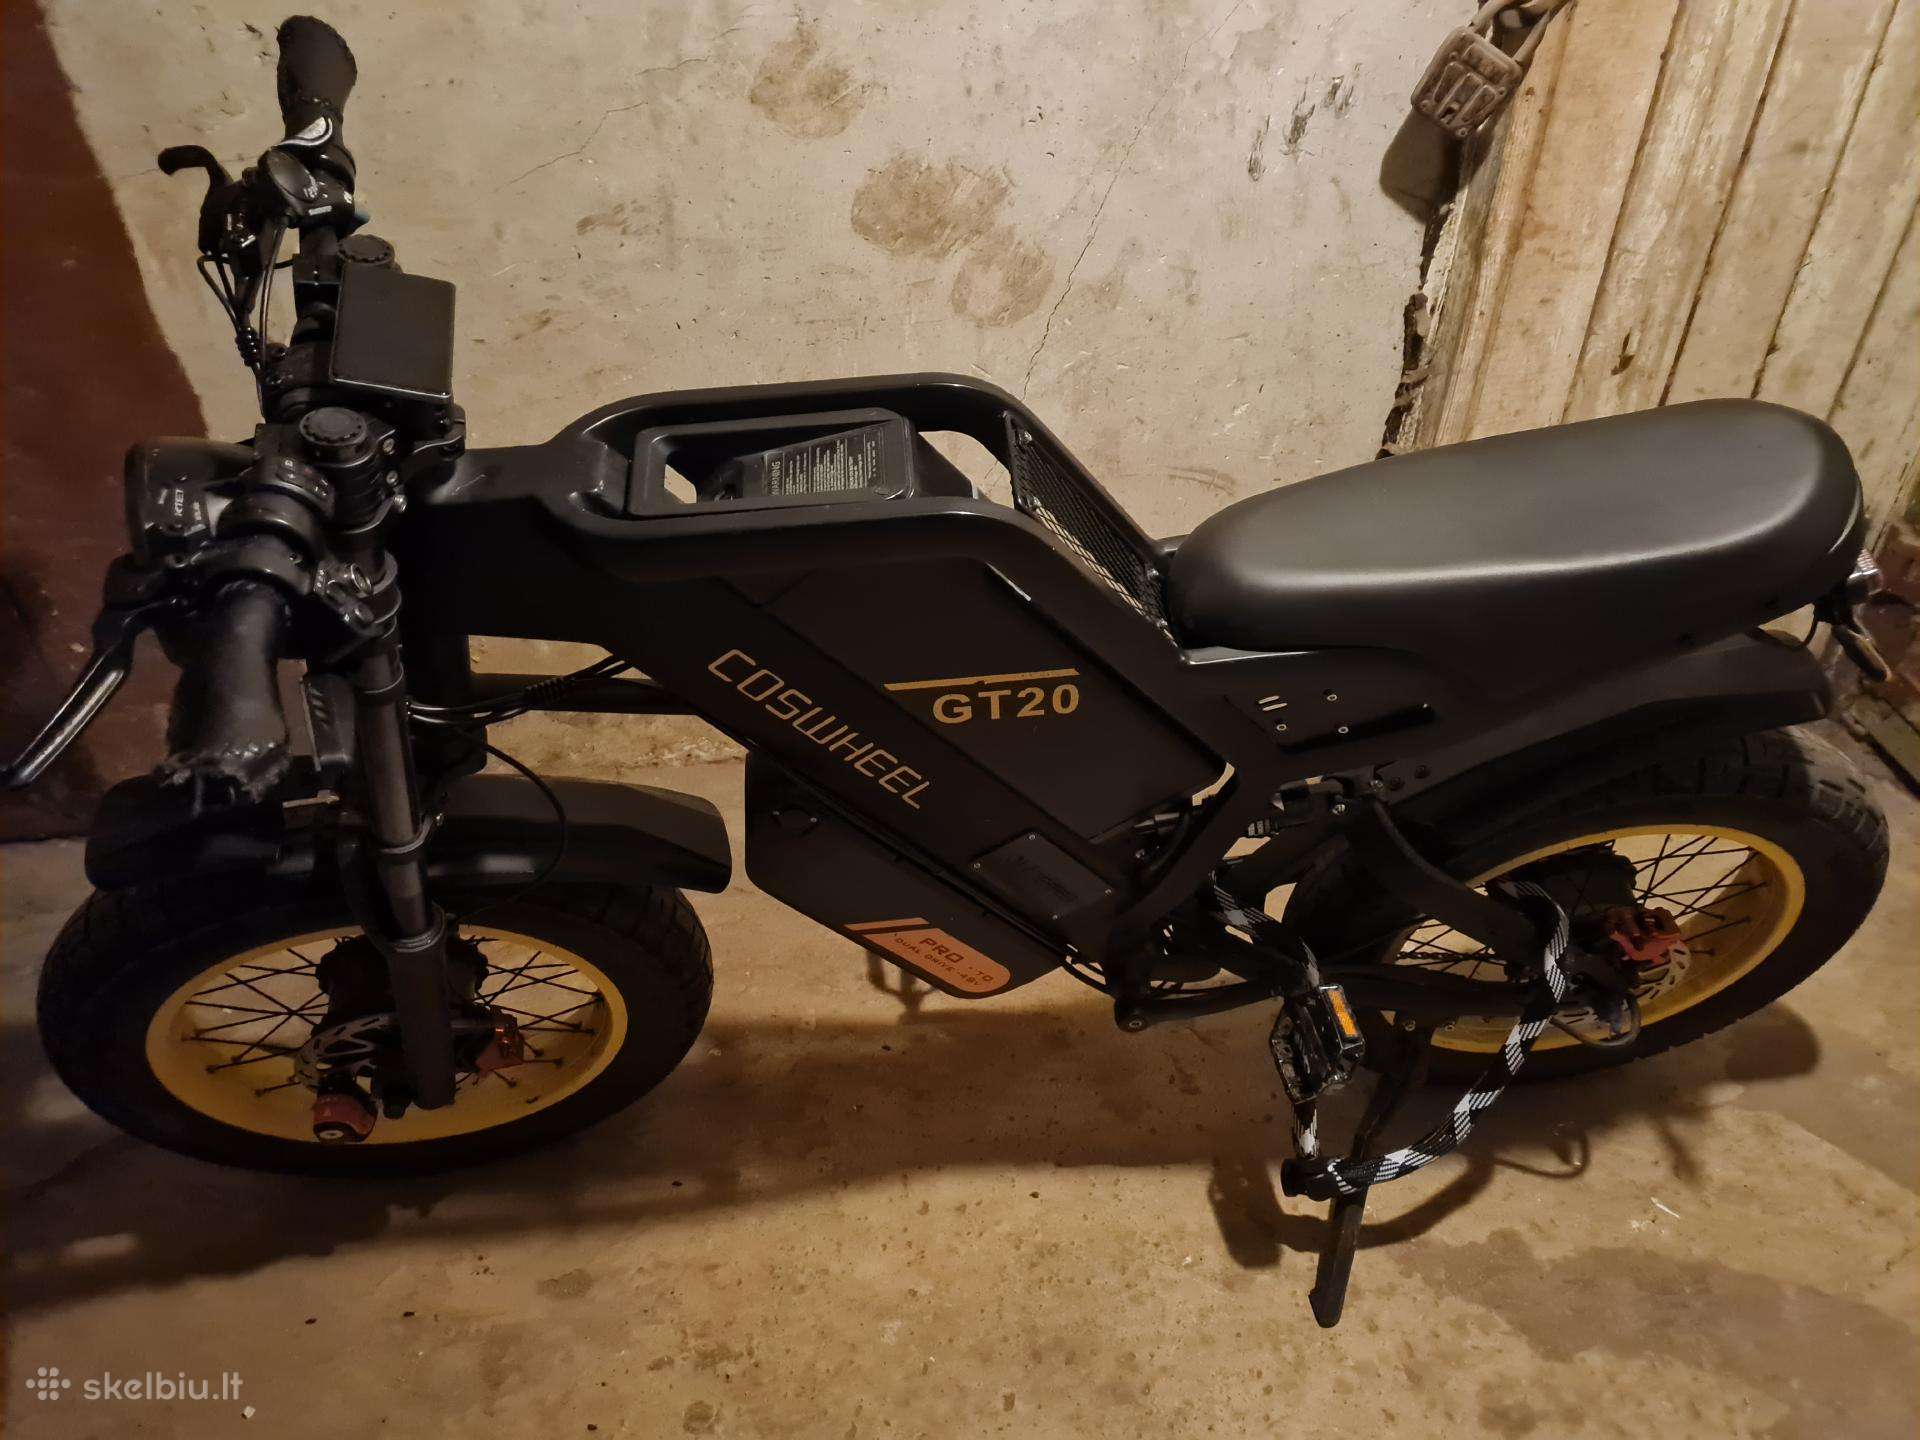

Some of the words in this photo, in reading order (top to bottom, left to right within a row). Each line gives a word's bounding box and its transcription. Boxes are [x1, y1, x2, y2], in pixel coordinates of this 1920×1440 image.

[932, 683, 1080, 725] GT20
[707, 648, 930, 811] COSWHEEL
[895, 937, 920, 954] DUAL
[919, 937, 964, 963] PRO
